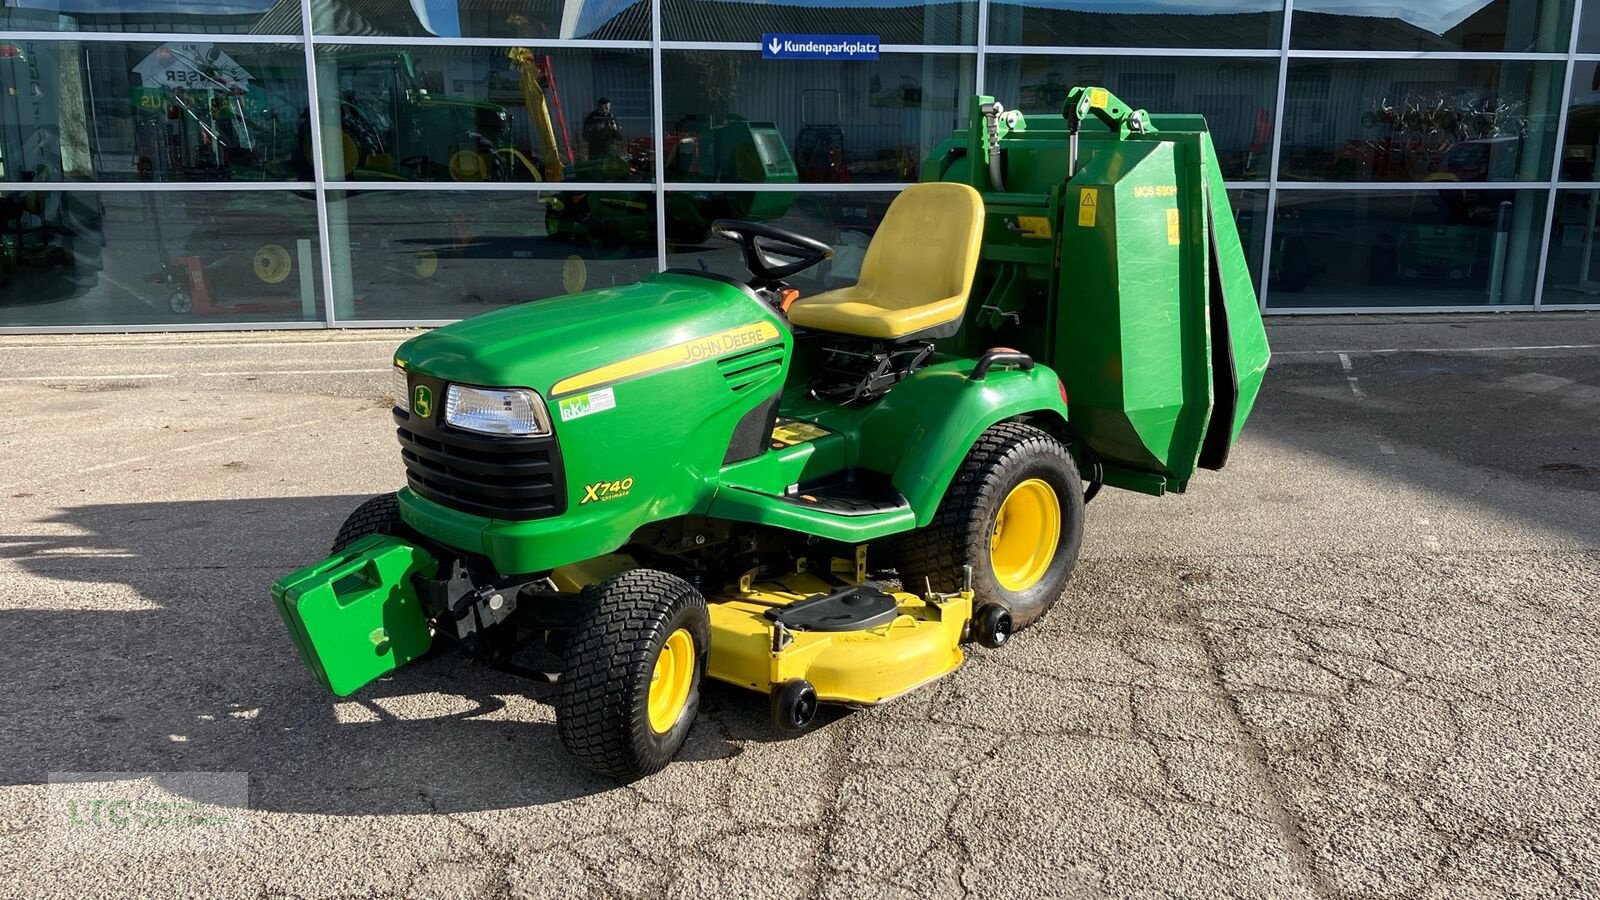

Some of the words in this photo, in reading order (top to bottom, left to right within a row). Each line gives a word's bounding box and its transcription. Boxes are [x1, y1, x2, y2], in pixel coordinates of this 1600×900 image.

[784, 40, 877, 55] Kundenparkplatz
[683, 340, 720, 361] JOHN
[721, 329, 764, 350] DEERE
[580, 477, 633, 504] X740
